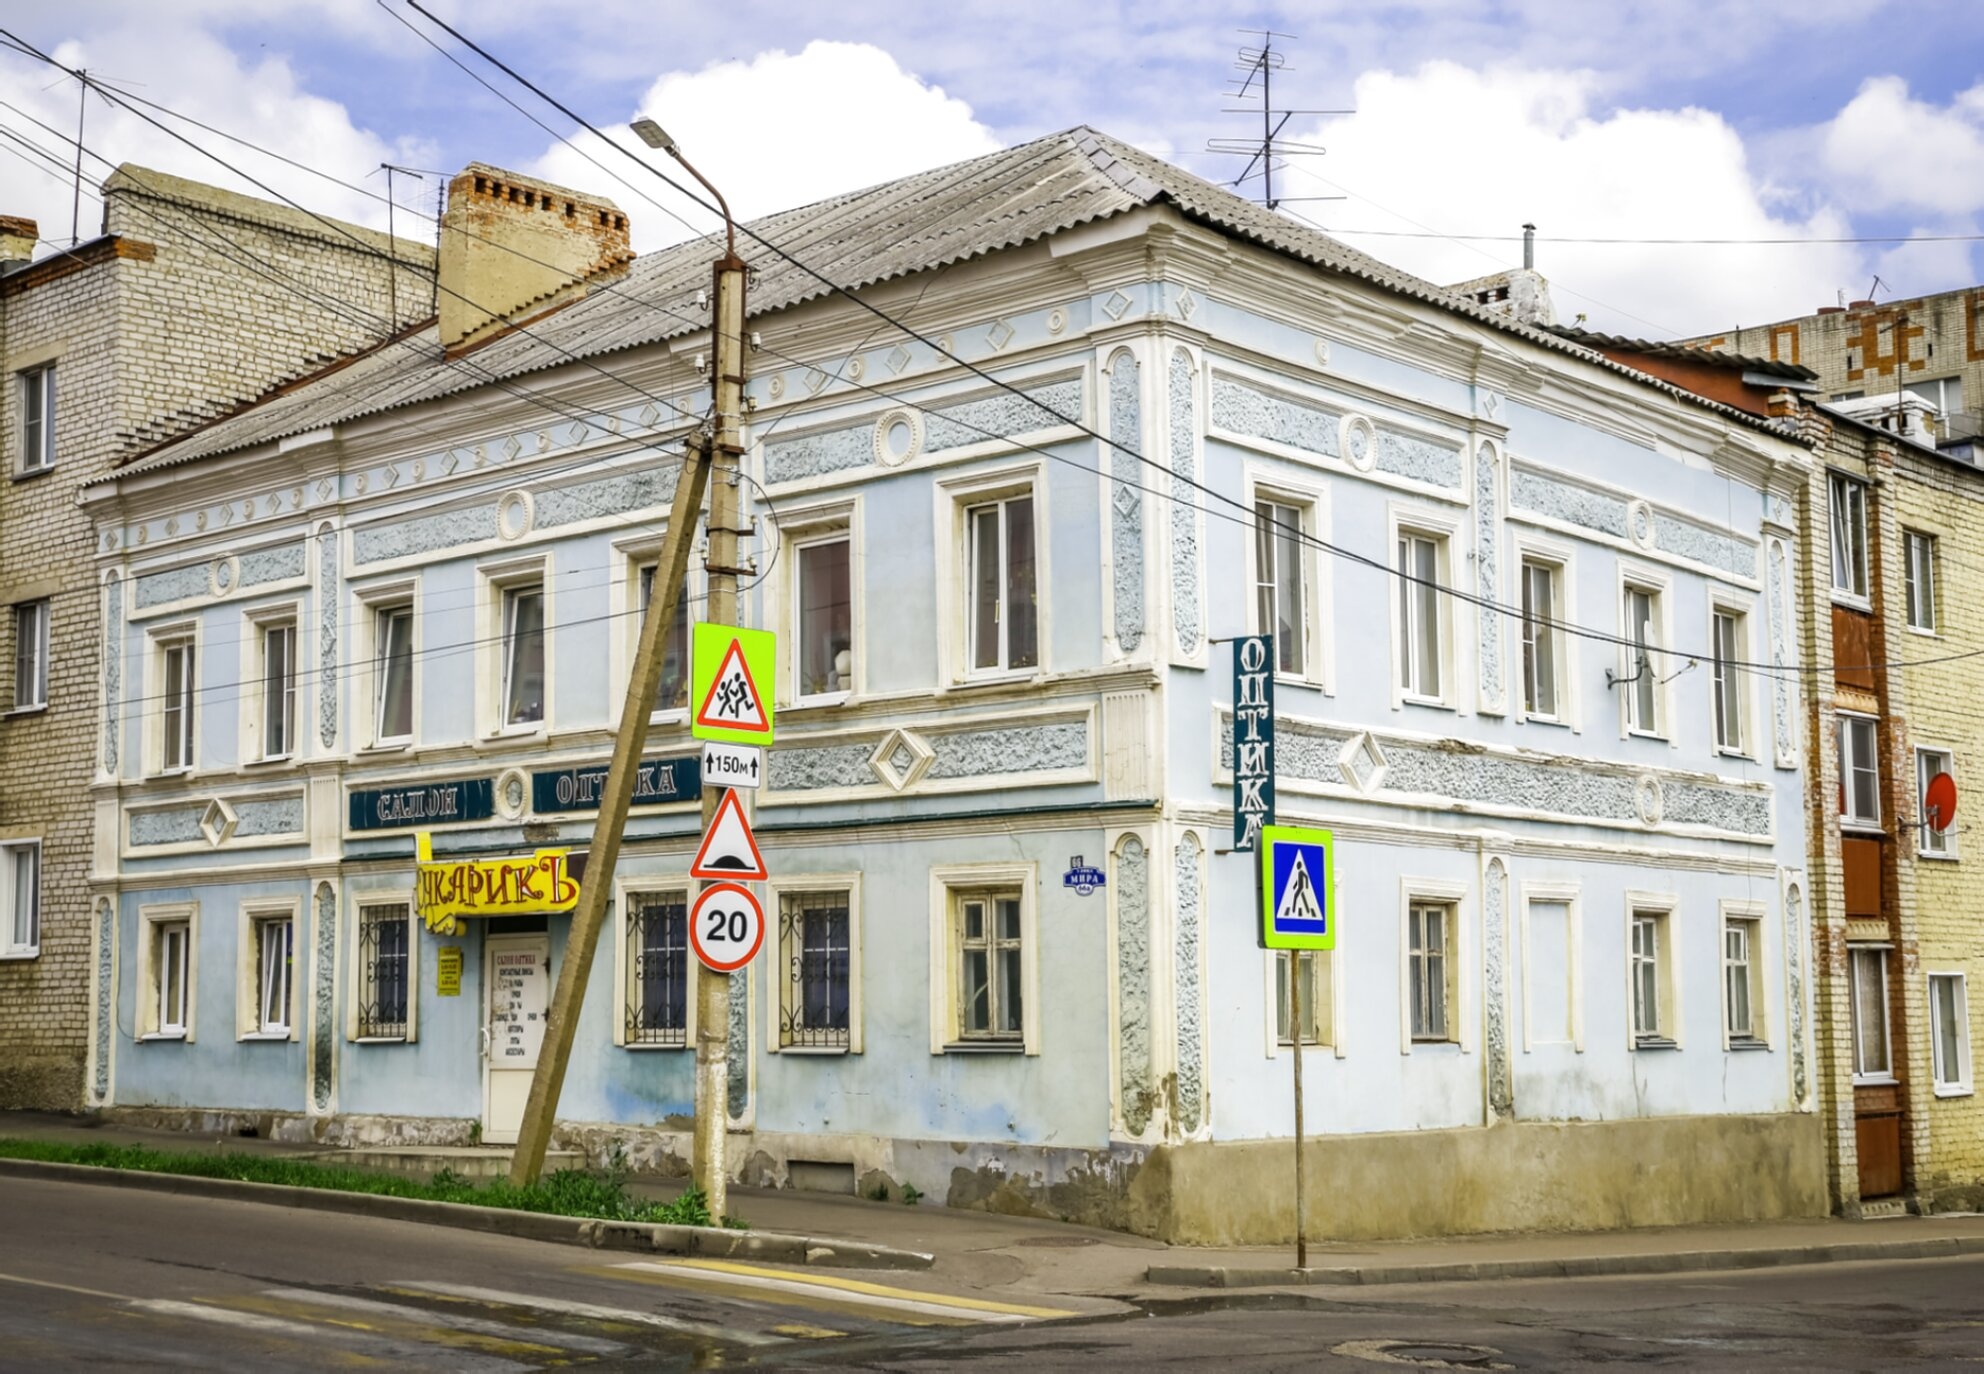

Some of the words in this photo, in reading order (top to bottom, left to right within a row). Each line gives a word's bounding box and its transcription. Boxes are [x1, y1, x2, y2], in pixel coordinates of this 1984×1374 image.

[376, 787, 458, 821] САЛОН
[556, 764, 677, 804] ОПТКА
[1070, 874, 1099, 884] МИРА
[706, 909, 748, 943] 20
